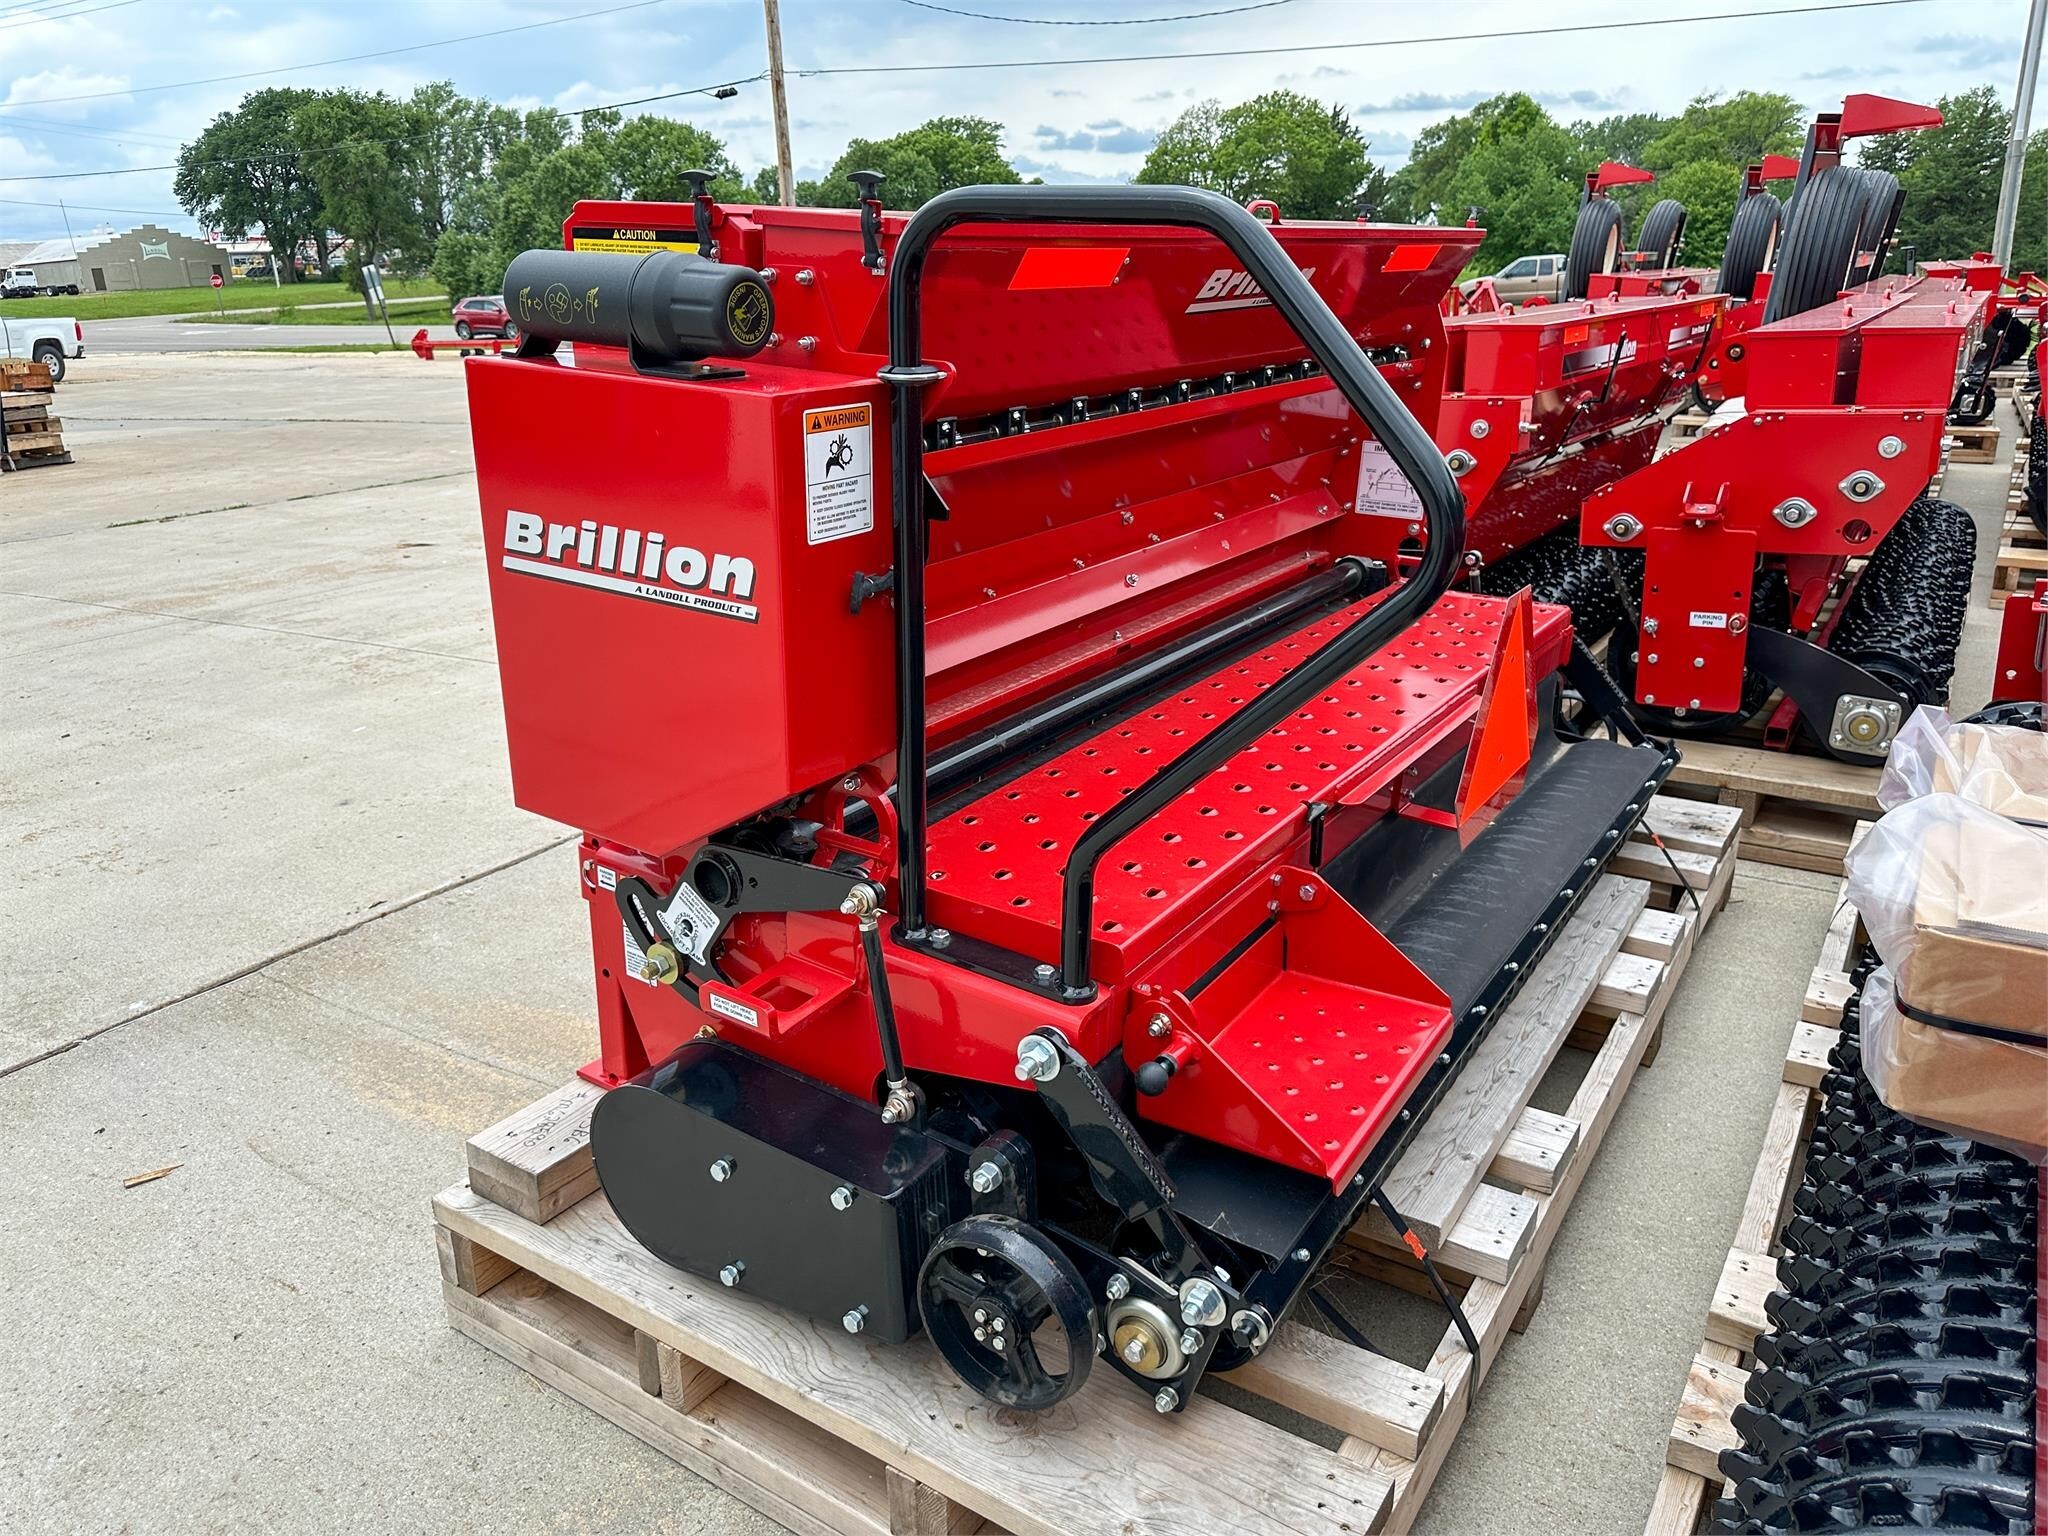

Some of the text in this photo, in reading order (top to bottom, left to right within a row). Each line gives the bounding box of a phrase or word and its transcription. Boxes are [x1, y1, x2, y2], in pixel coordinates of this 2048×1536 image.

[620, 229, 656, 240] CAUTION
[730, 285, 746, 308] INSIDE
[732, 321, 754, 341] MANUAL
[824, 410, 865, 427] WARNING
[504, 510, 755, 599] Brillion
[635, 585, 742, 613] A LANDOLL PRODUCT
